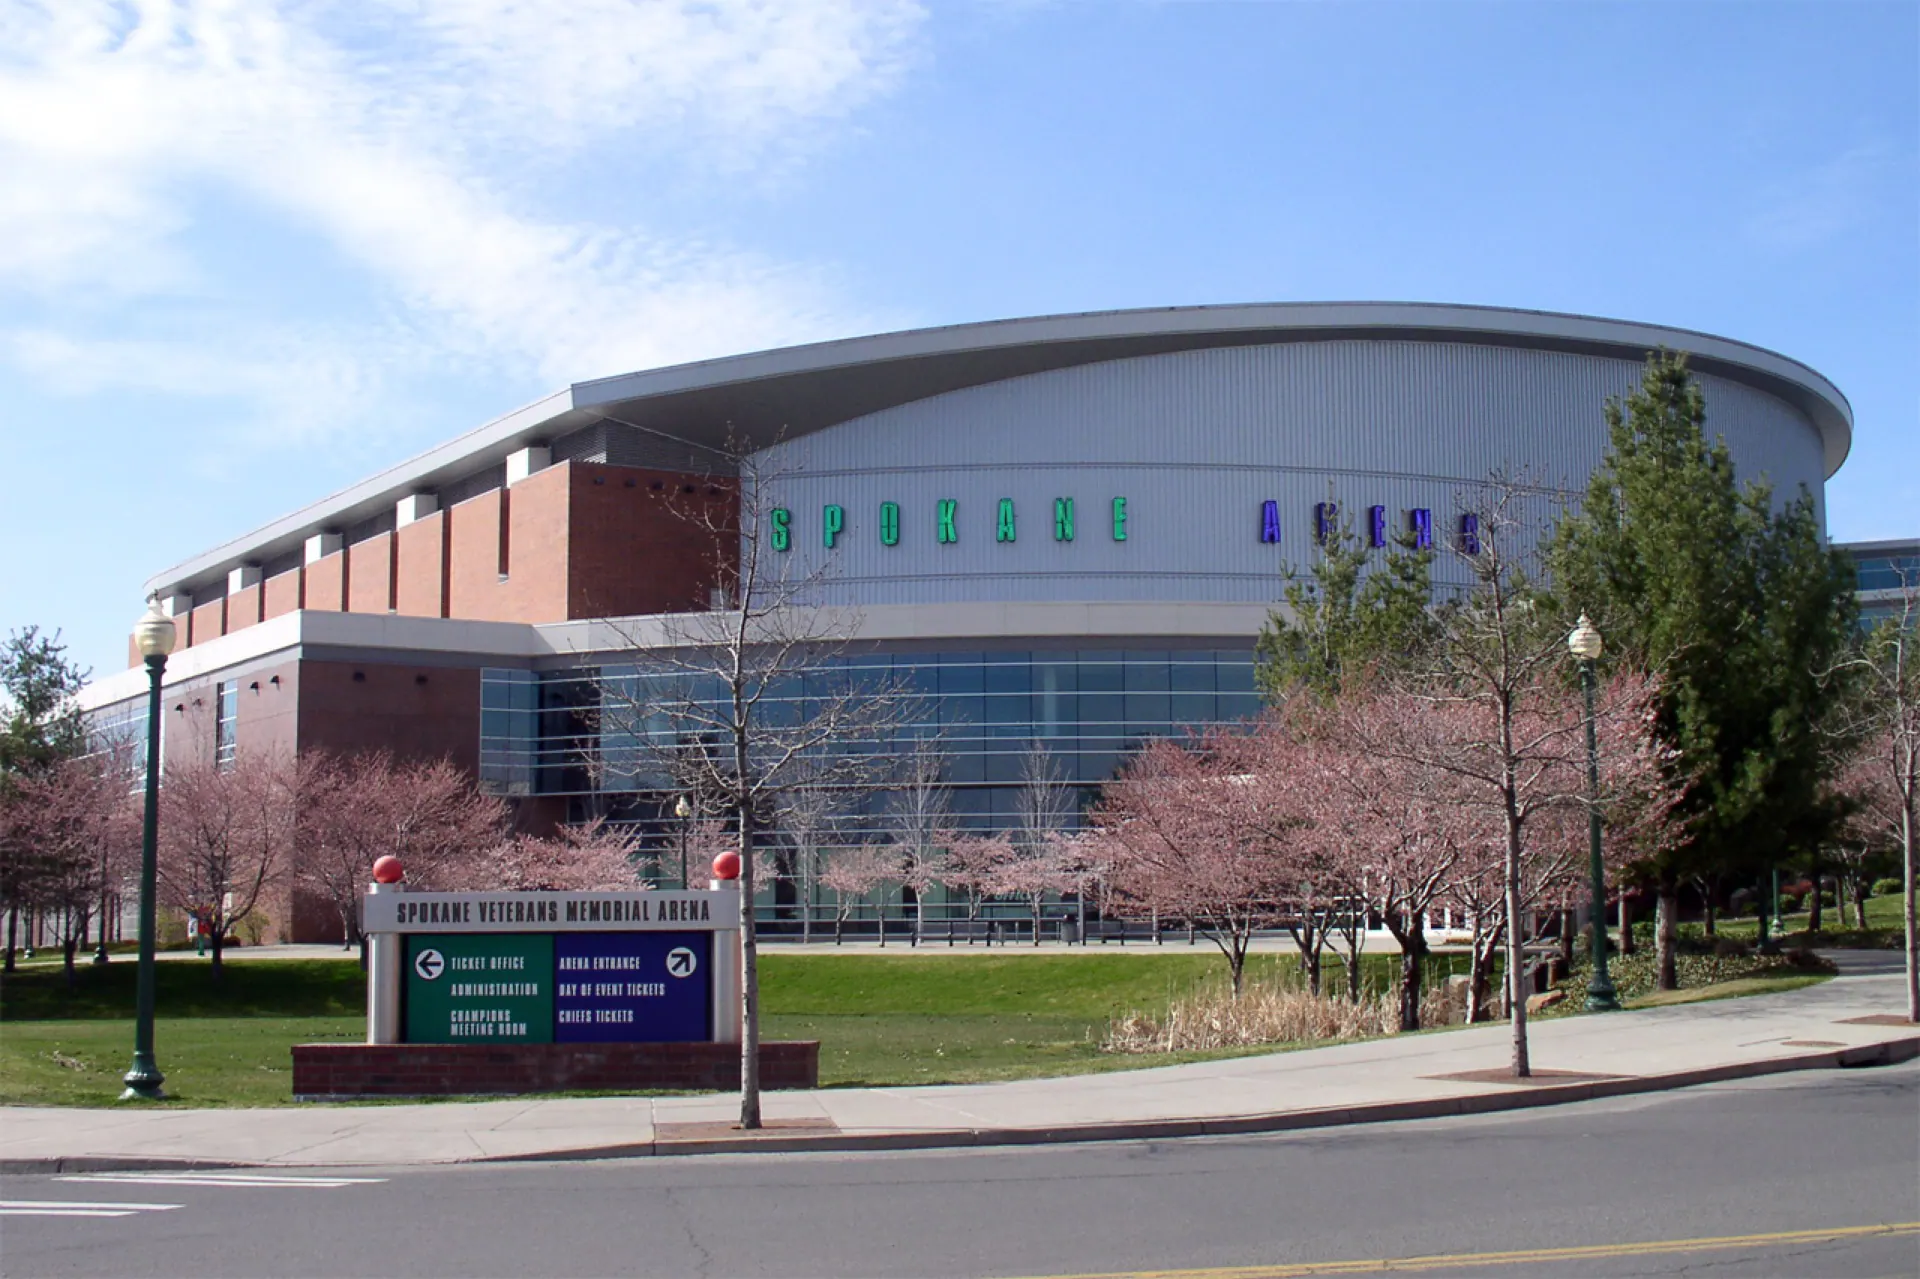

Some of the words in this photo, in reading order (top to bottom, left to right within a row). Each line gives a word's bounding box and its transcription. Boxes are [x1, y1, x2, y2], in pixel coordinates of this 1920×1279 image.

[771, 498, 1127, 552] SPOKANE
[1260, 501, 1480, 555] ARENA
[397, 900, 471, 925] SPOKANE
[477, 900, 558, 924] VETERANS
[565, 899, 651, 923] MEMORIAL
[657, 899, 711, 923] ARENA
[451, 957, 486, 970] TICKET
[490, 956, 525, 970] OFFICE
[559, 956, 590, 970] ARENA
[593, 956, 641, 970] ENTRANCE
[450, 983, 539, 996] ADMINISTRATION
[559, 983, 577, 997] DAY
[581, 983, 592, 997] OF
[595, 983, 624, 997] EVENT
[627, 983, 666, 996] TICKETS
[450, 1010, 511, 1022] CHAMPIONS
[559, 1010, 592, 1023] CHIEFS
[596, 1010, 634, 1023] TICKETS
[450, 1023, 494, 1036] MEETING
[499, 1023, 527, 1036] ROOM
